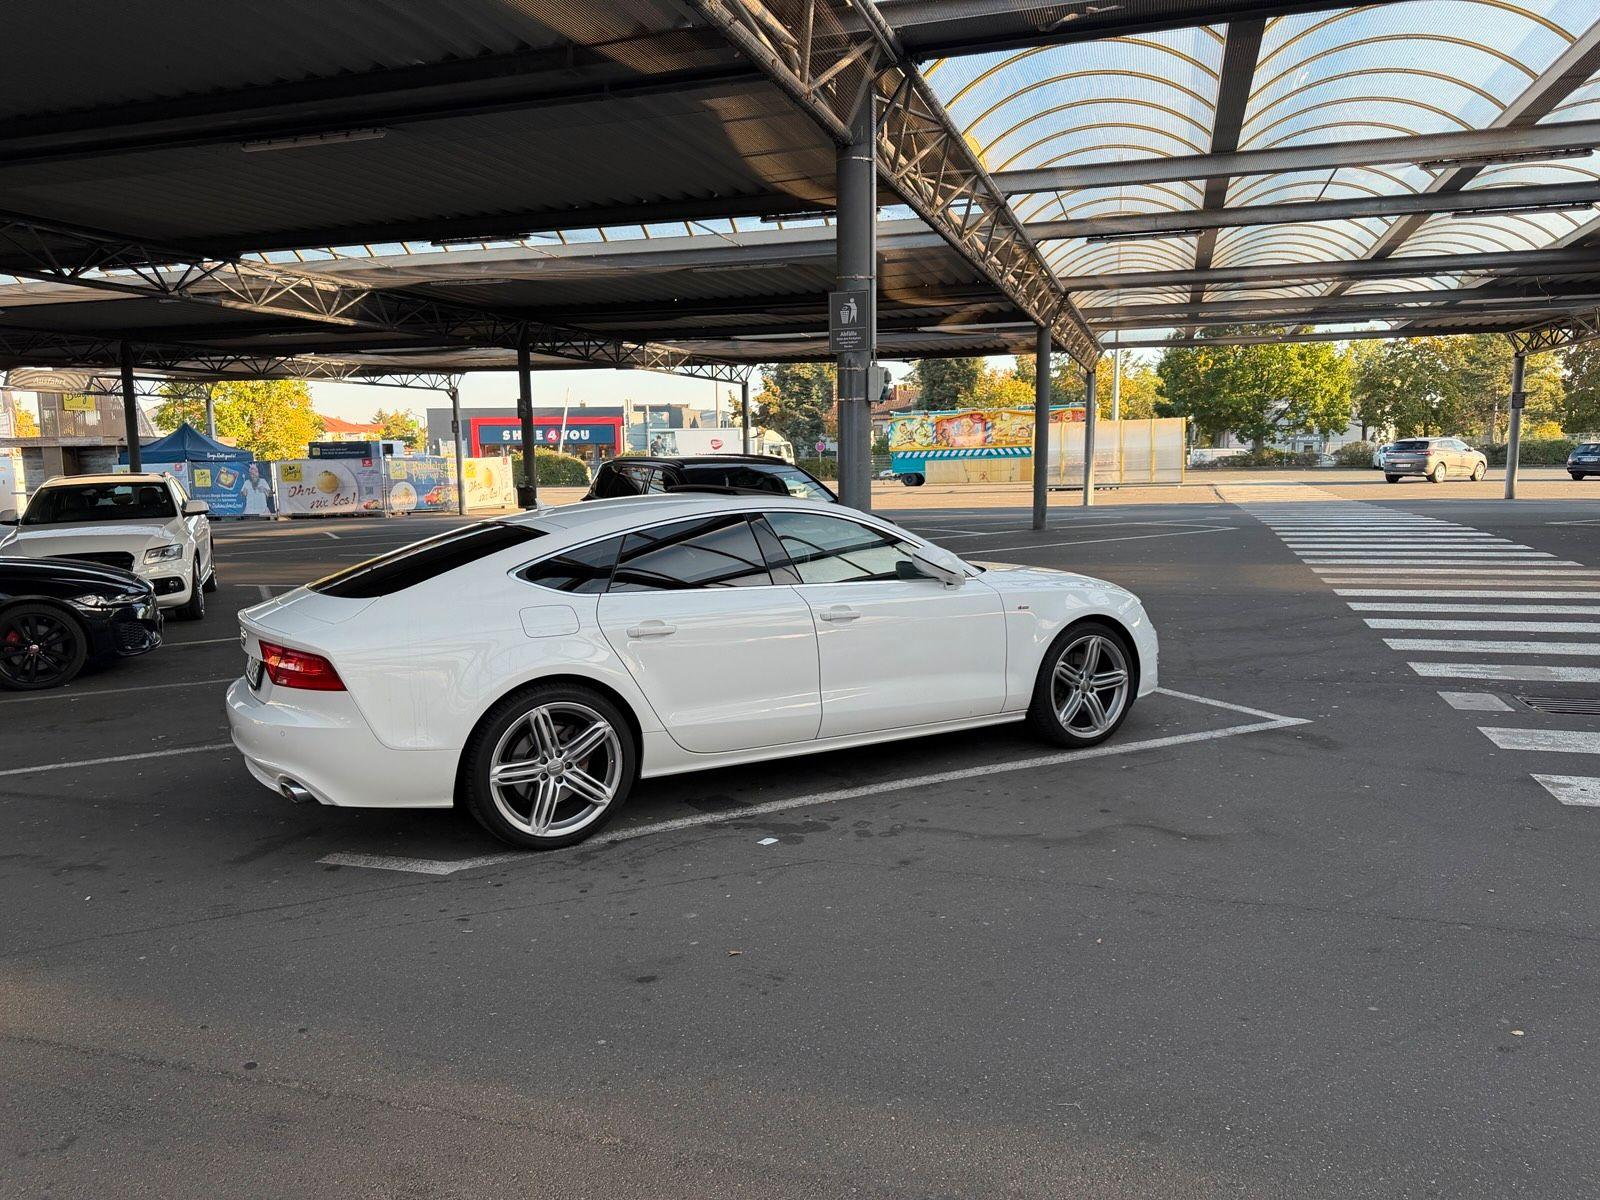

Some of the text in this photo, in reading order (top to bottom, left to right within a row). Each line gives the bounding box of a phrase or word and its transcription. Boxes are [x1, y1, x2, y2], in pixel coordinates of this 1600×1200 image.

[502, 430, 544, 440] SHE
[288, 484, 317, 498] Ohne
[310, 499, 329, 509] nix
